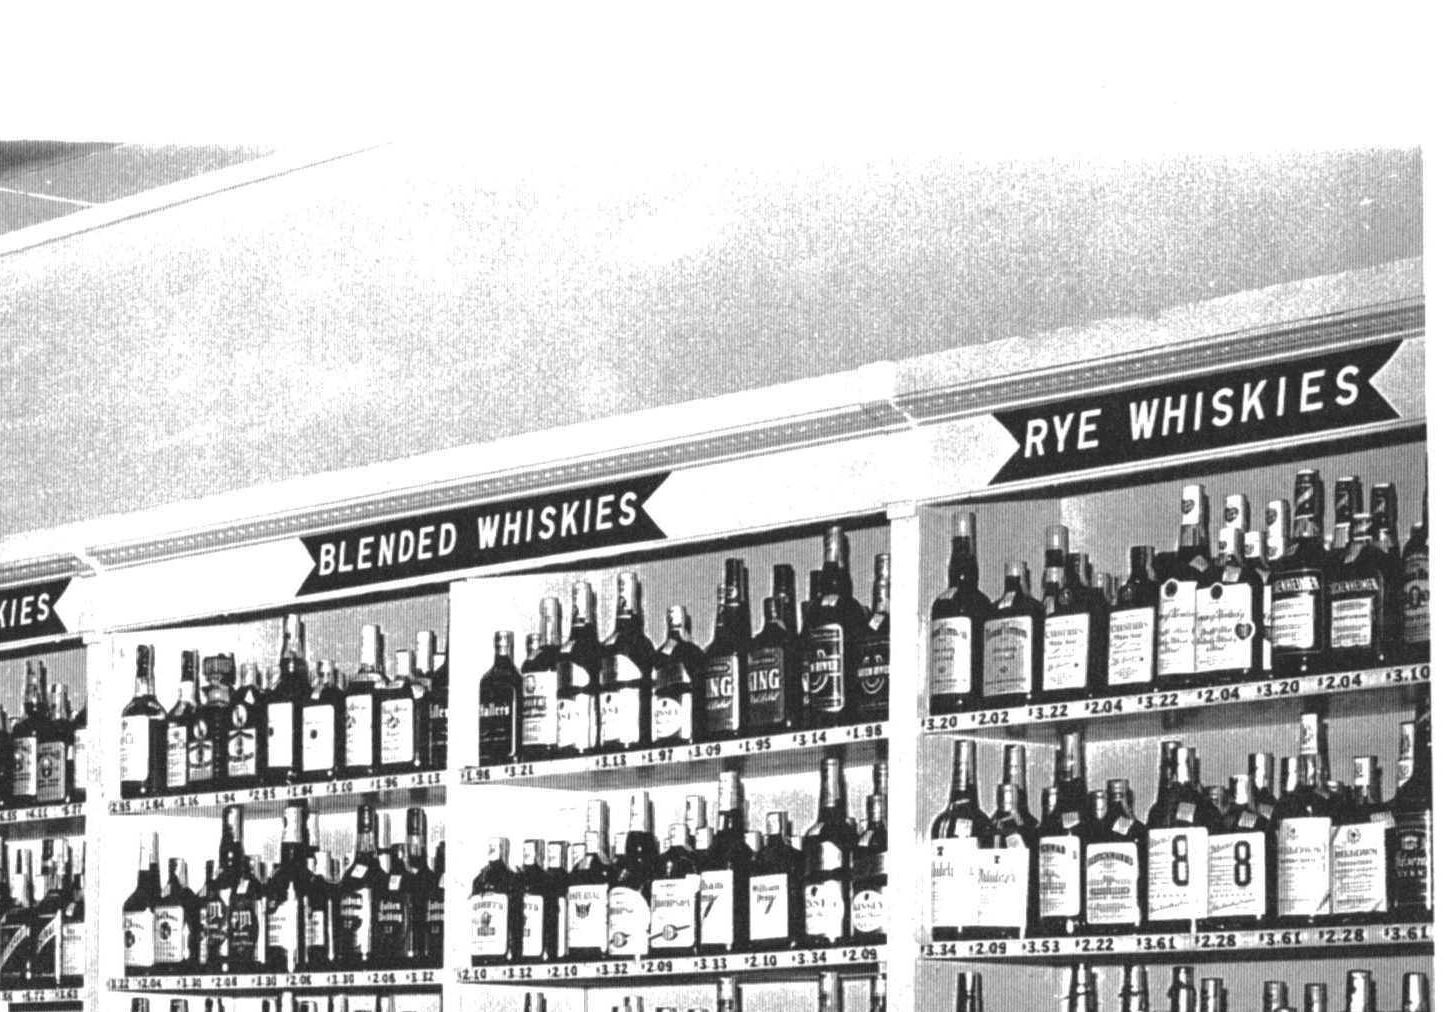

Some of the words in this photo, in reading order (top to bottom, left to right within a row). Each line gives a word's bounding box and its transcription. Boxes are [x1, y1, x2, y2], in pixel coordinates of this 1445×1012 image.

[1024, 409, 1102, 458] RYE
[1129, 365, 1360, 441] WHISKIES
[319, 523, 456, 577] BLENDED
[478, 490, 638, 549] WHISKIES
[706, 676, 733, 699] NG
[921, 716, 959, 731] $3.20
[971, 711, 1010, 726] $2.02
[1028, 704, 1068, 721] $3.22
[1084, 699, 1123, 715] $2.04
[1137, 693, 1179, 710] $3.22
[1196, 686, 1241, 702] $2.04
[1256, 680, 1300, 697] $3.20
[1317, 673, 1362, 691] $2.04
[1385, 665, 1431, 683] $3.10
[641, 749, 674, 763] $1.97
[688, 744, 722, 758] $3.09
[739, 738, 772, 752] $1.95
[793, 731, 827, 745] $3.14
[1171, 834, 1190, 887] 8
[1234, 840, 1252, 887] 8
[458, 968, 488, 980] $2.10
[503, 967, 533, 979] $3.32
[547, 965, 578, 977] $2.10
[596, 963, 629, 975] $3.32
[641, 960, 673, 972] $2.09
[694, 957, 727, 970] $3.33
[744, 954, 778, 967] $2.10
[791, 952, 827, 964] $3.34
[842, 948, 878, 961] $2.09
[921, 942, 957, 956] $3.34
[968, 941, 1007, 955] $2.09
[1021, 938, 1060, 954] $3.53
[1074, 937, 1114, 952] $2.22
[1136, 935, 1176, 950] $3.61
[1194, 933, 1237, 949] $2.28
[1258, 930, 1302, 946] $3.61
[1318, 928, 1365, 944] $2.28
[1383, 925, 1430, 942] $3.61
